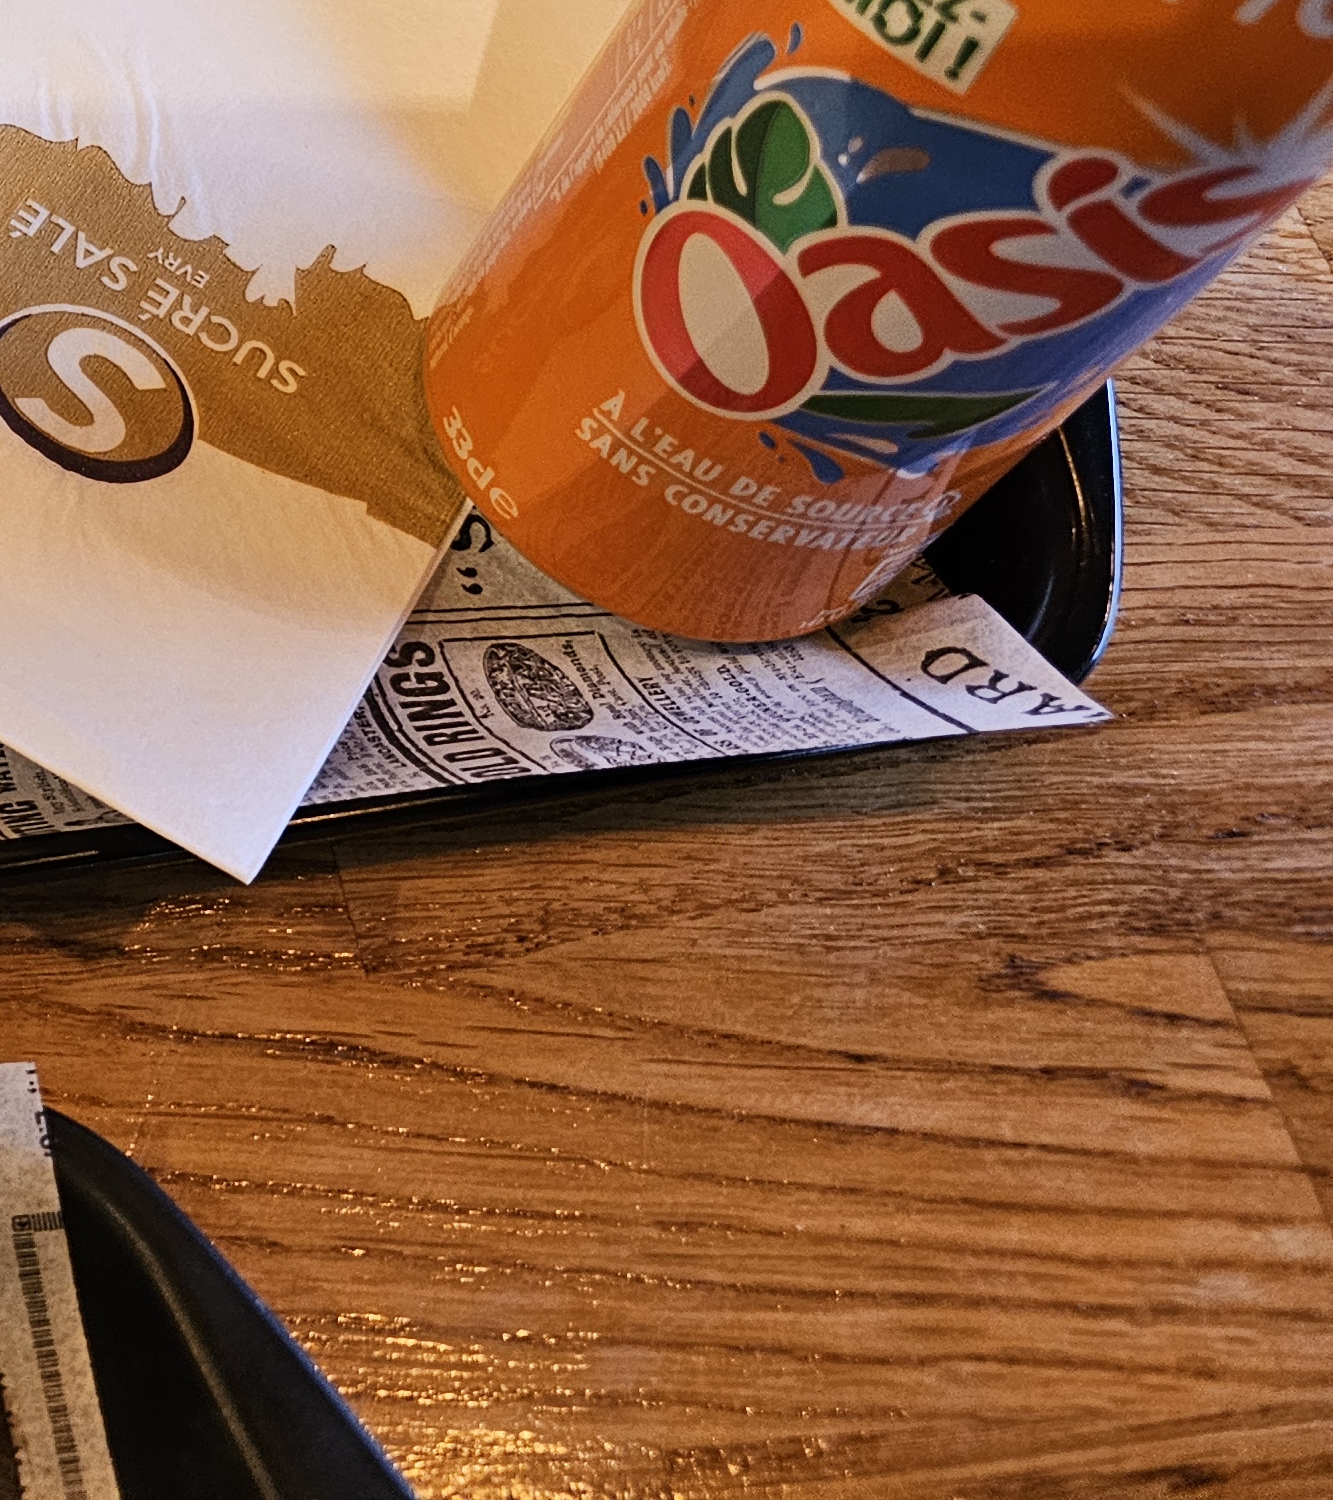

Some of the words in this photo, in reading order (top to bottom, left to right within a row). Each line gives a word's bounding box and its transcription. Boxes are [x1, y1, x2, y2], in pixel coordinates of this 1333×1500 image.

[8, 199, 138, 291] SALÉ
[146, 245, 209, 289] EVRY
[138, 278, 309, 393] SUCRÉ
[574, 416, 655, 488] SANS
[595, 389, 627, 421] À
[631, 424, 723, 482] L'EAU
[728, 475, 779, 507] DE
